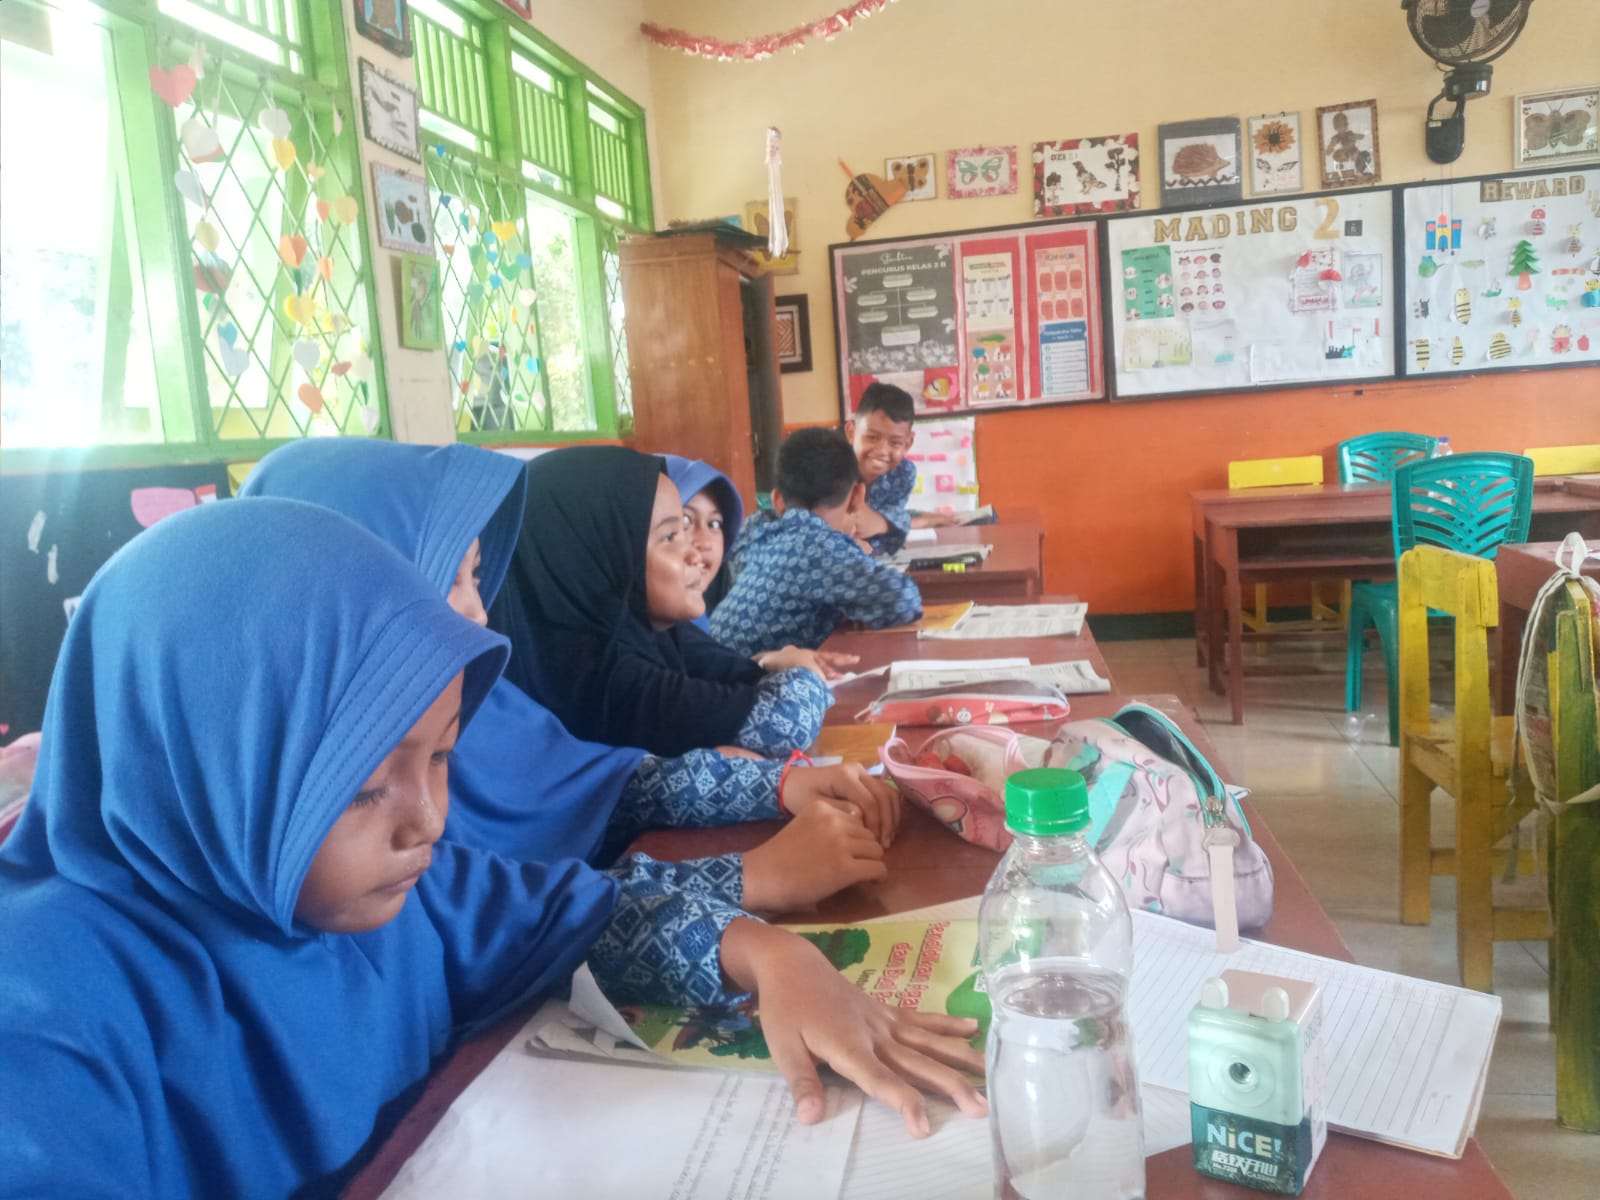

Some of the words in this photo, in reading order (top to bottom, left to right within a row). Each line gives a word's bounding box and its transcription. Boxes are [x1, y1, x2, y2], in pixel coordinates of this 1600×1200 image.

[1482, 174, 1585, 202] REWARD
[1154, 206, 1298, 243] MADING
[1313, 198, 1340, 240] 2
[906, 262, 932, 272] KELAS
[1207, 1123, 1283, 1160] NiCE!
